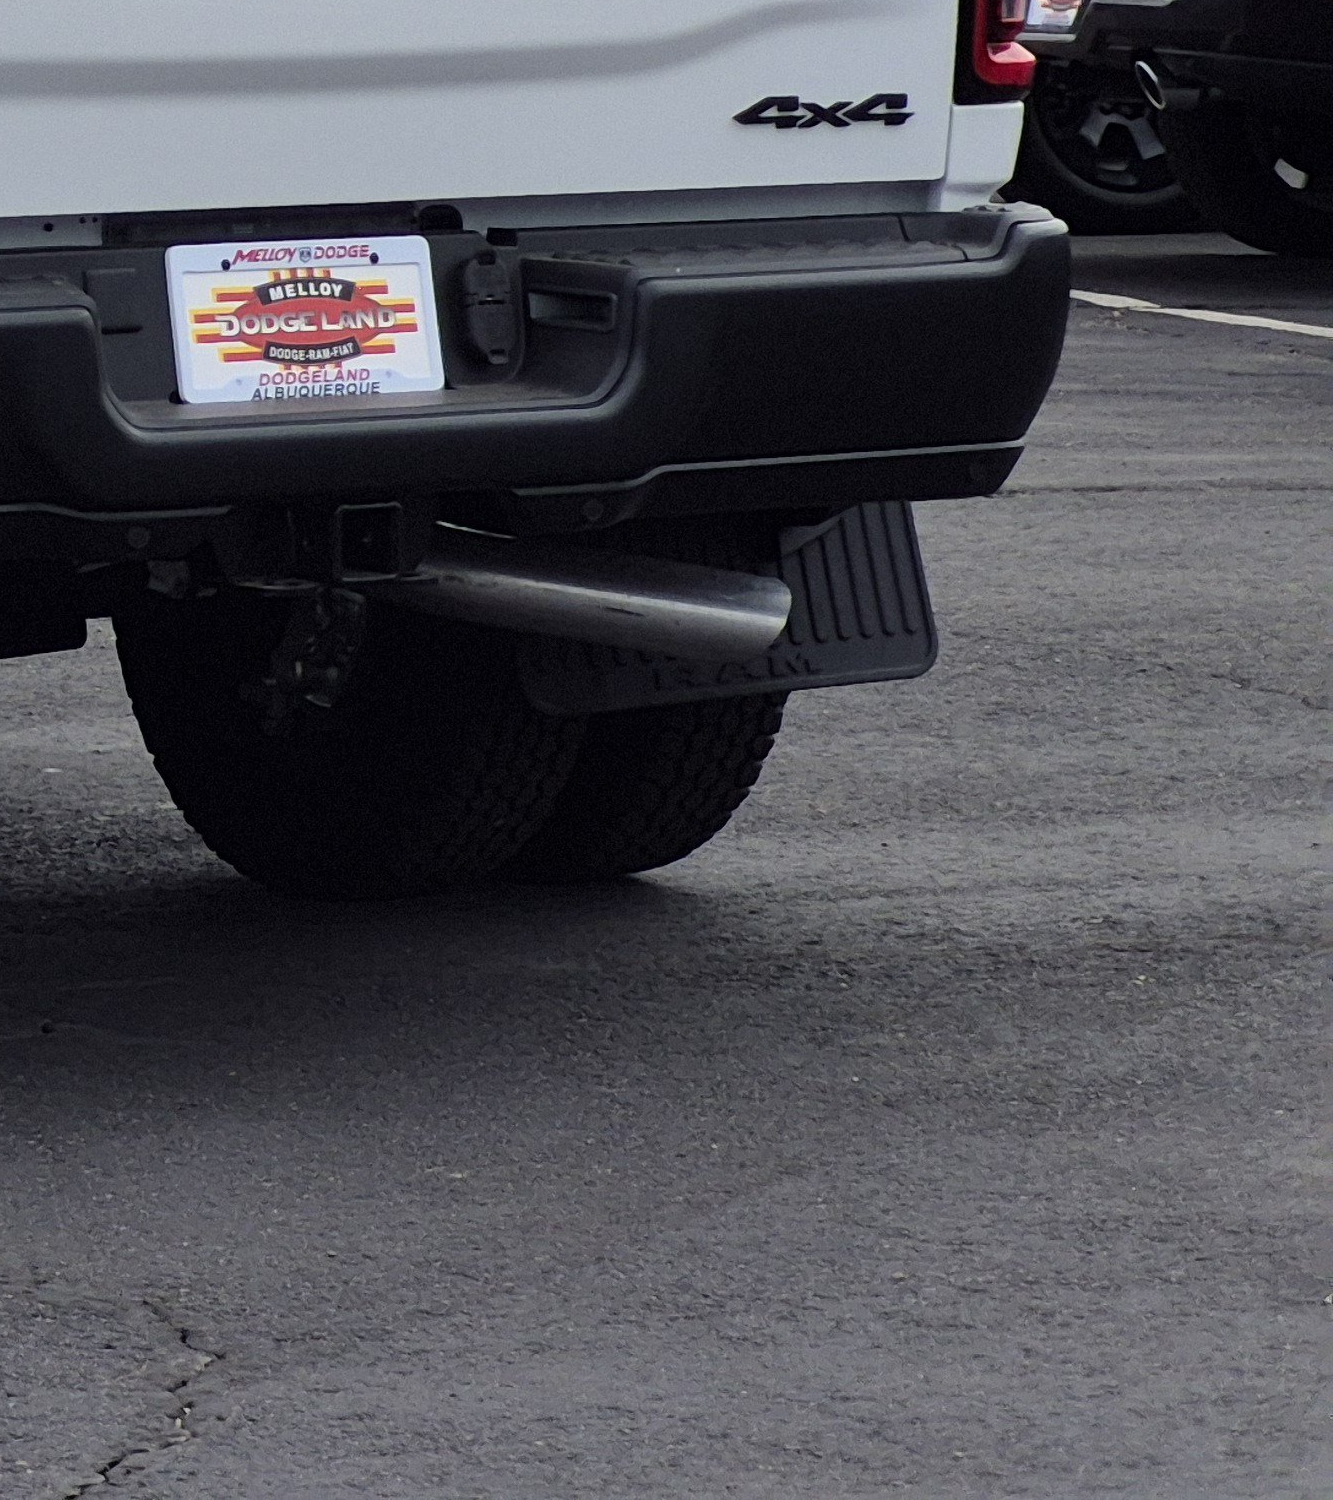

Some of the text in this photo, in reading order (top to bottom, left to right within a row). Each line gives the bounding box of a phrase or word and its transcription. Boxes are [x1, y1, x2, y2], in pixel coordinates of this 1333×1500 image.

[732, 93, 915, 129] 4x4
[232, 244, 370, 265] MELLOY DODGE
[268, 281, 343, 301] MELLOY
[259, 368, 371, 387] DODGELAND
[251, 381, 382, 401] ALBUQUERQUE
